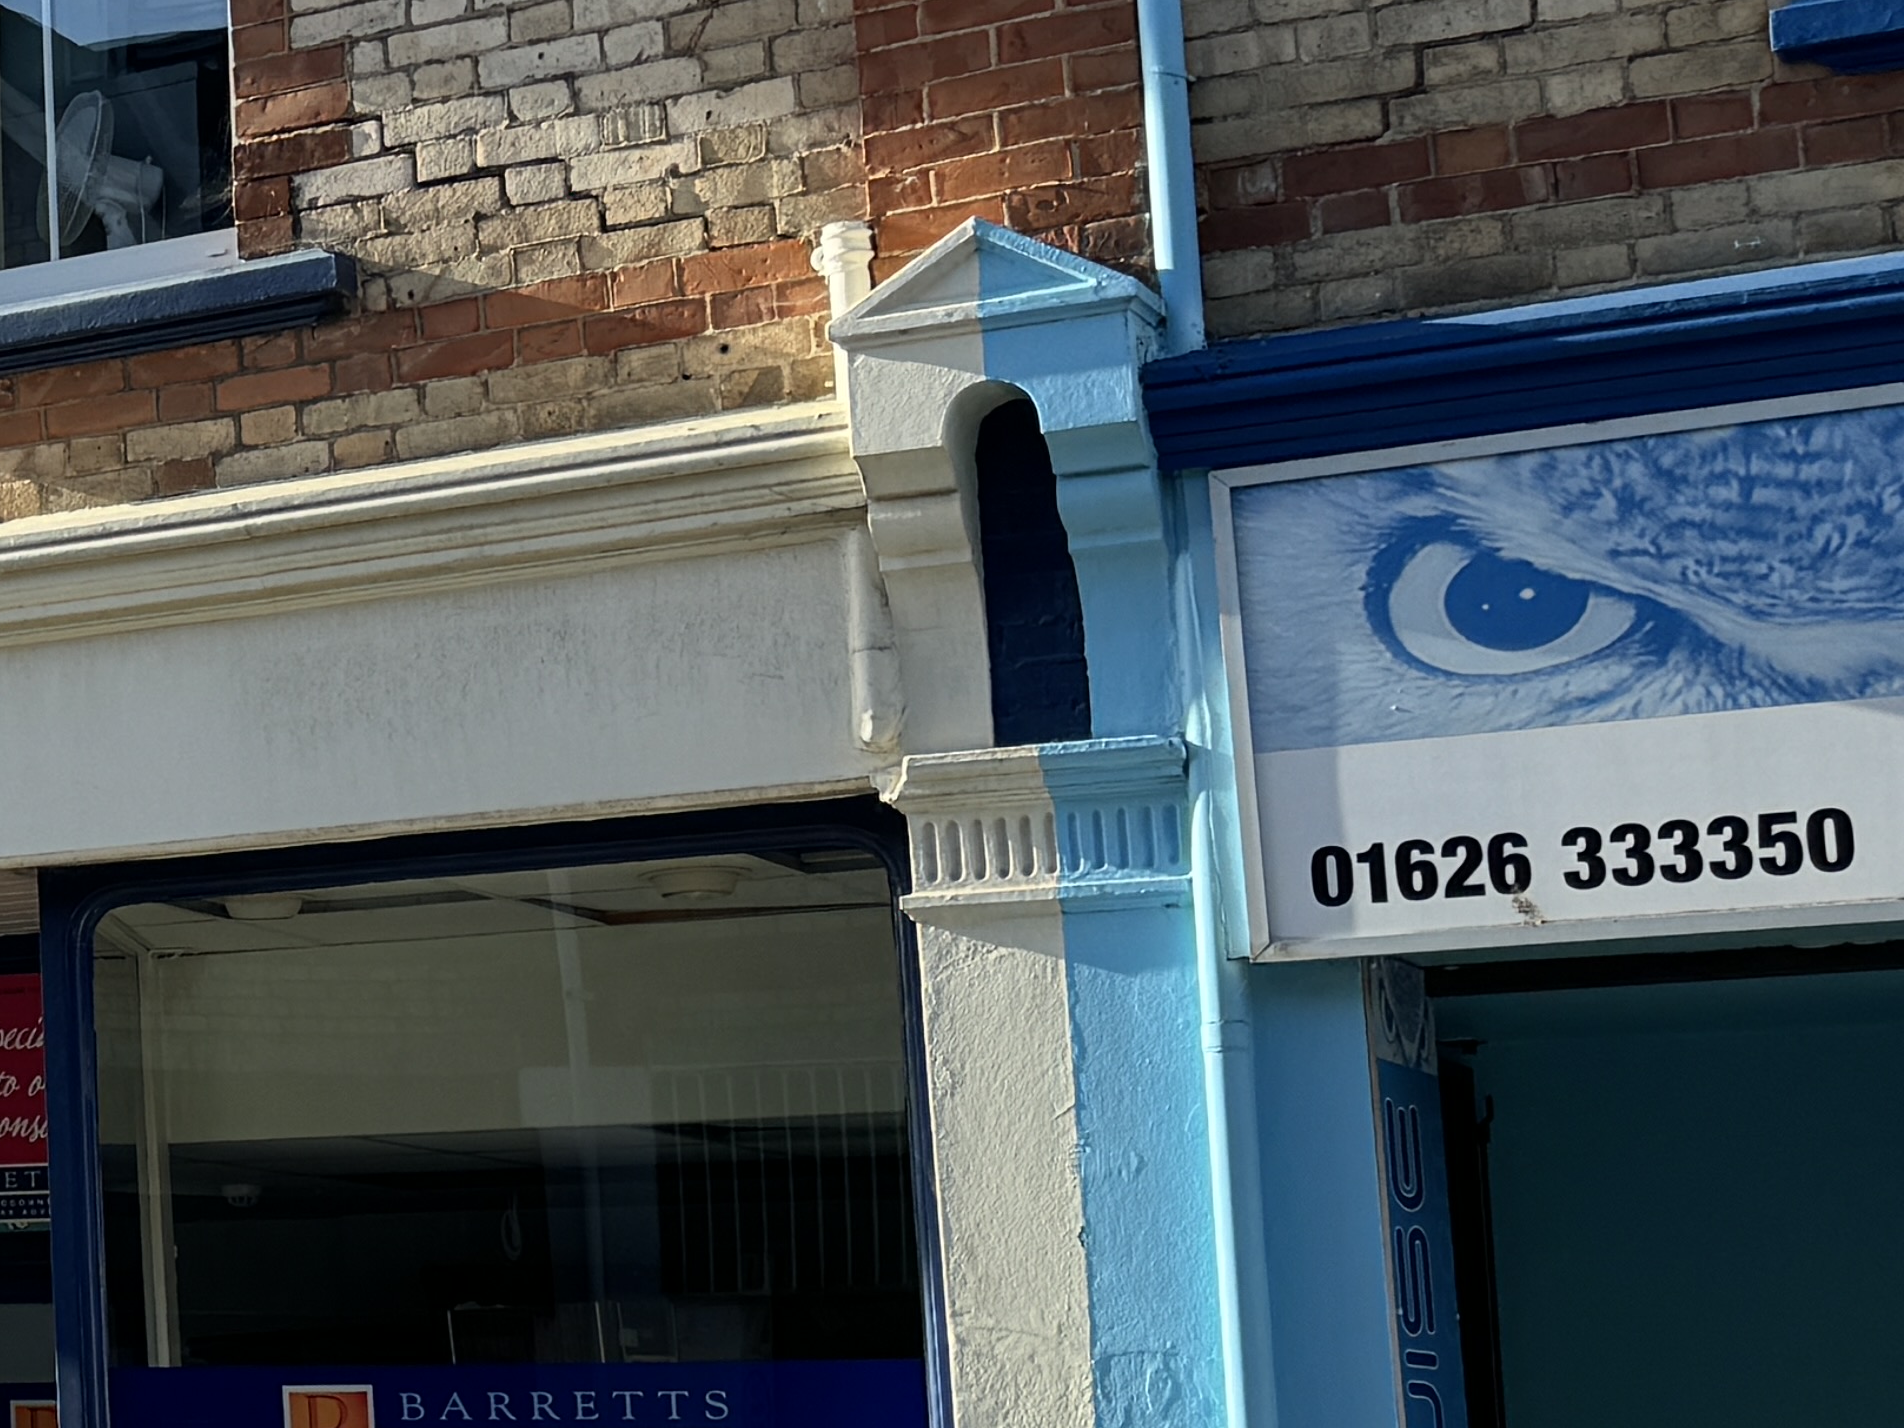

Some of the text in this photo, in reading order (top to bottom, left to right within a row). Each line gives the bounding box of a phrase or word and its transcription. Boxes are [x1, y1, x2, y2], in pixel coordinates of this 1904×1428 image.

[1310, 807, 1855, 908] 01626 333350
[399, 1390, 730, 1421] BARRETTS
